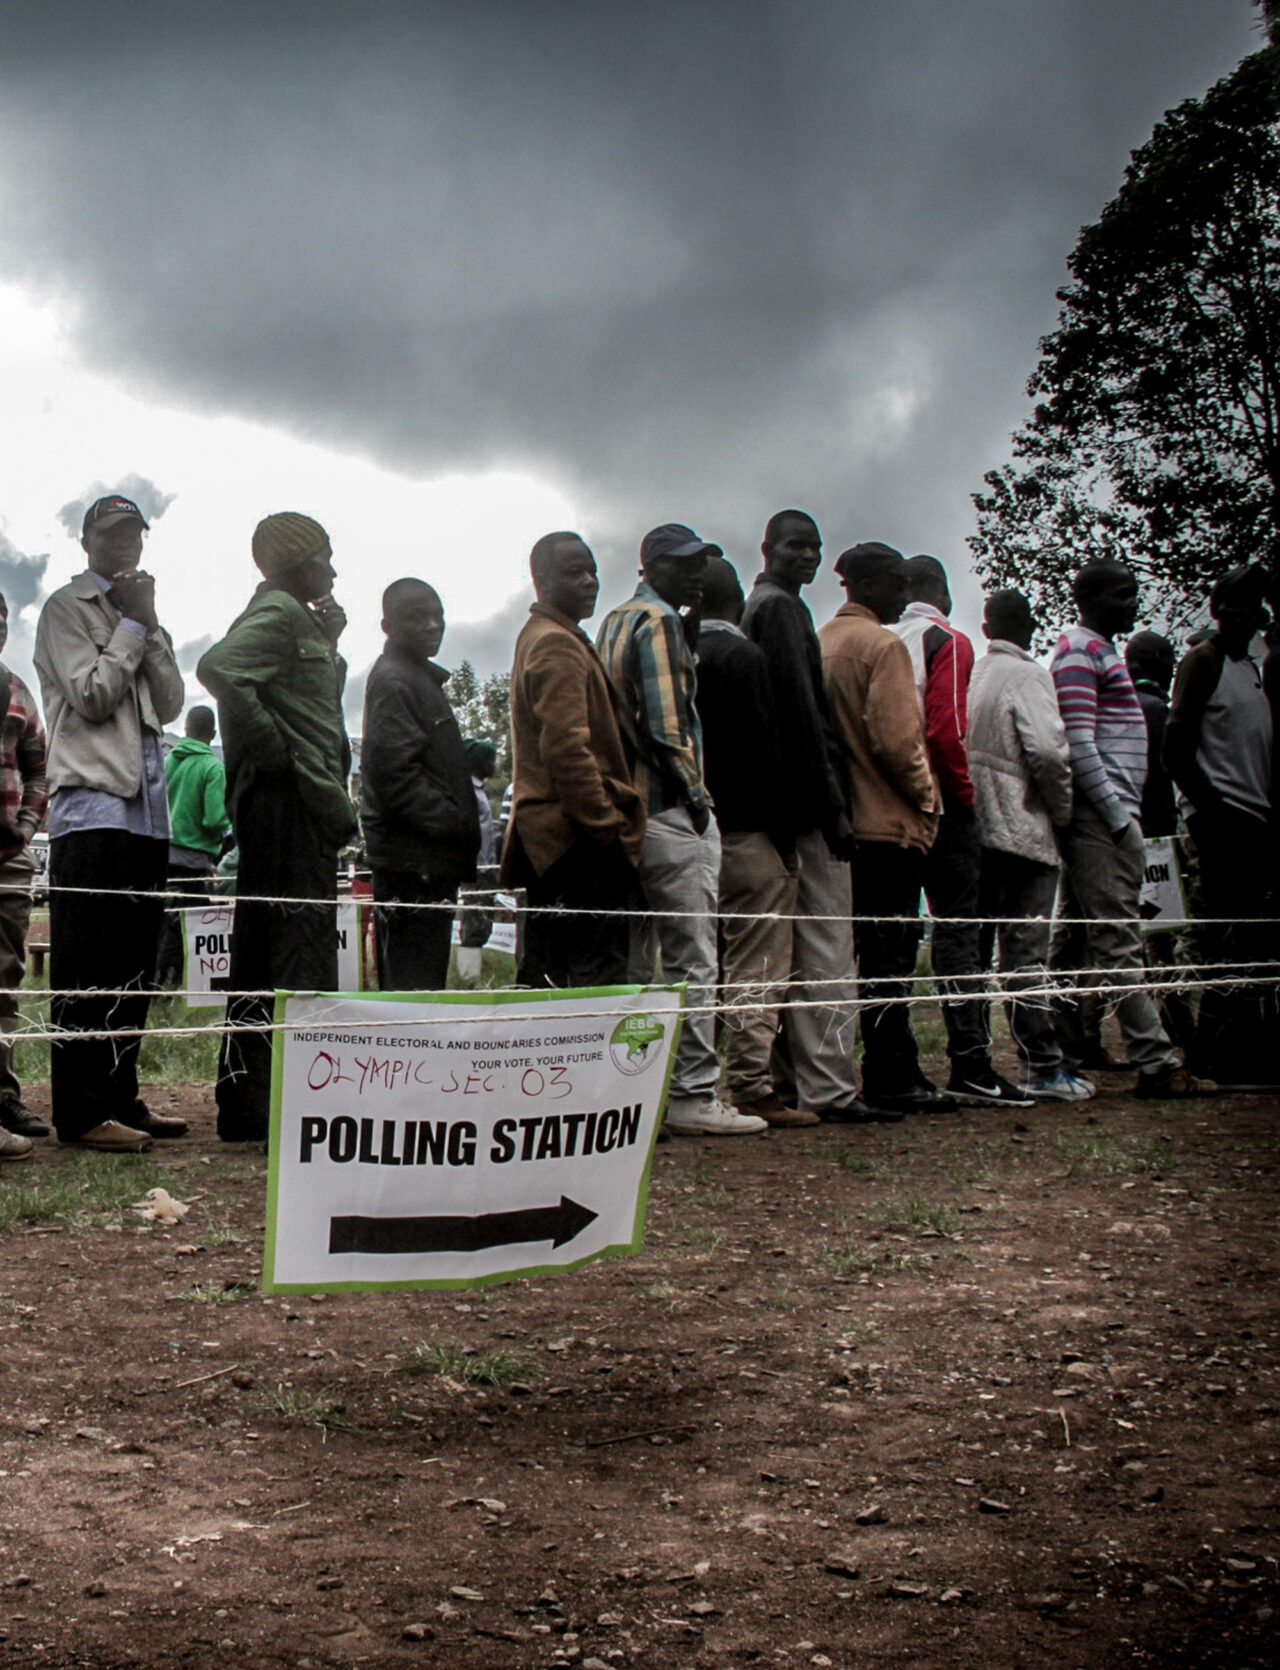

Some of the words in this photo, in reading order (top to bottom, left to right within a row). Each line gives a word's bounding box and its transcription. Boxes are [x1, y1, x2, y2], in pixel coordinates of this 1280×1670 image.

[1143, 863, 1170, 884] ION
[200, 957, 229, 975] NO
[625, 1018, 655, 1029] IEBC
[292, 1032, 373, 1046] INDEPENDENT
[376, 1037, 444, 1049] ELECTORAL
[447, 1041, 471, 1050] AND
[473, 1037, 541, 1051] BOUNDARIES
[544, 1032, 605, 1047] COMMISSION
[471, 1059, 502, 1070] YOUR
[536, 1056, 564, 1066] YOUR
[566, 1051, 604, 1063] FUTURE
[308, 1051, 433, 1094] OLYMPIC
[521, 1067, 573, 1100] 03
[300, 1115, 477, 1166] POLLING
[490, 1103, 642, 1164] STATION
